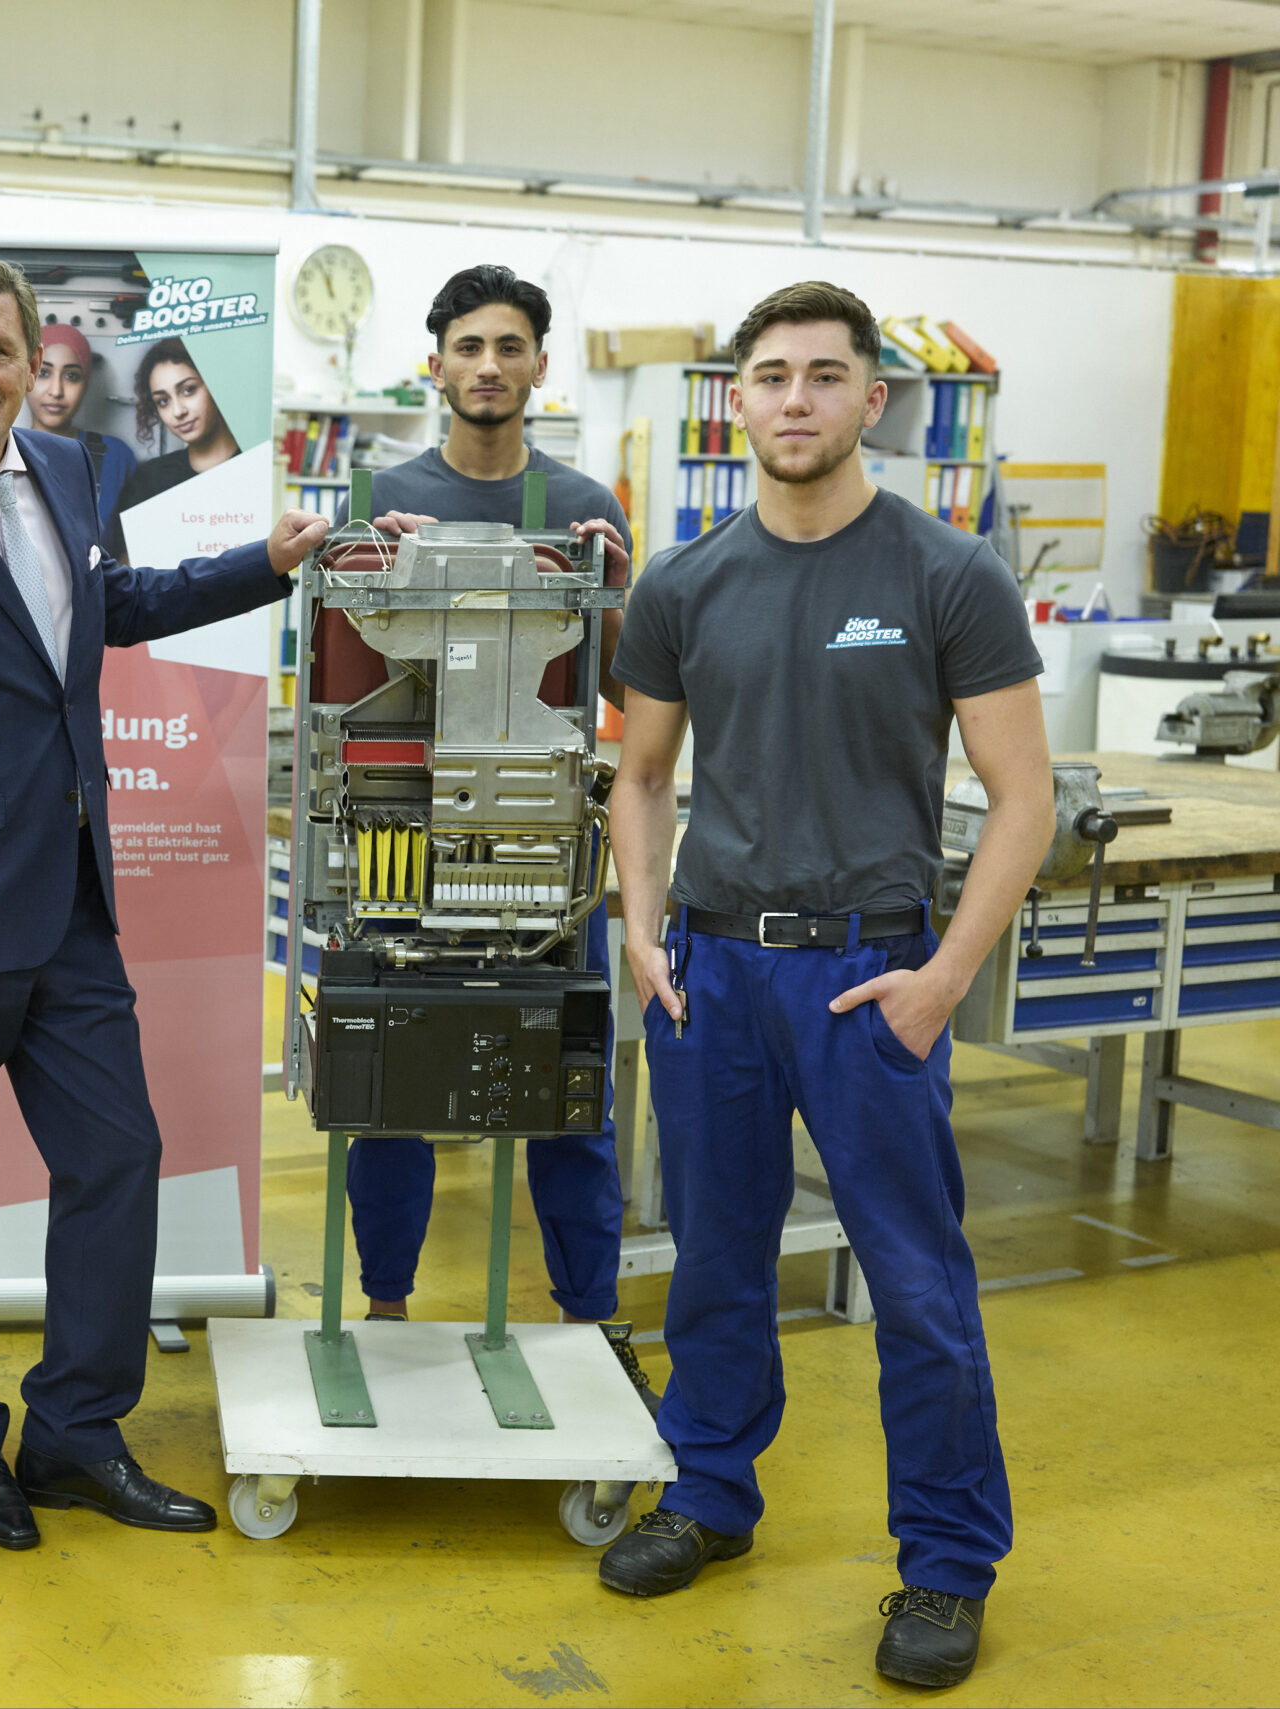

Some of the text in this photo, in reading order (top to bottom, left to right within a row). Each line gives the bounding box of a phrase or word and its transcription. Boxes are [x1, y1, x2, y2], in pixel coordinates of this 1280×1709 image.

[147, 277, 212, 308] ÖKO
[133, 294, 257, 332] BOOSTER
[117, 315, 266, 345] Deine Ausbildung für unsere Zukunft
[181, 511, 254, 526] Los geht's!
[844, 617, 880, 632] ÖKO
[835, 628, 903, 643] BOOSTER
[169, 822, 192, 833] und
[195, 823, 222, 834] hast
[126, 837, 143, 848] als
[147, 837, 219, 848] Elektriker:in
[149, 851, 172, 862] und
[175, 852, 199, 862] tust
[202, 853, 230, 864] ganz
[332, 1016, 375, 1024] Thermoblock
